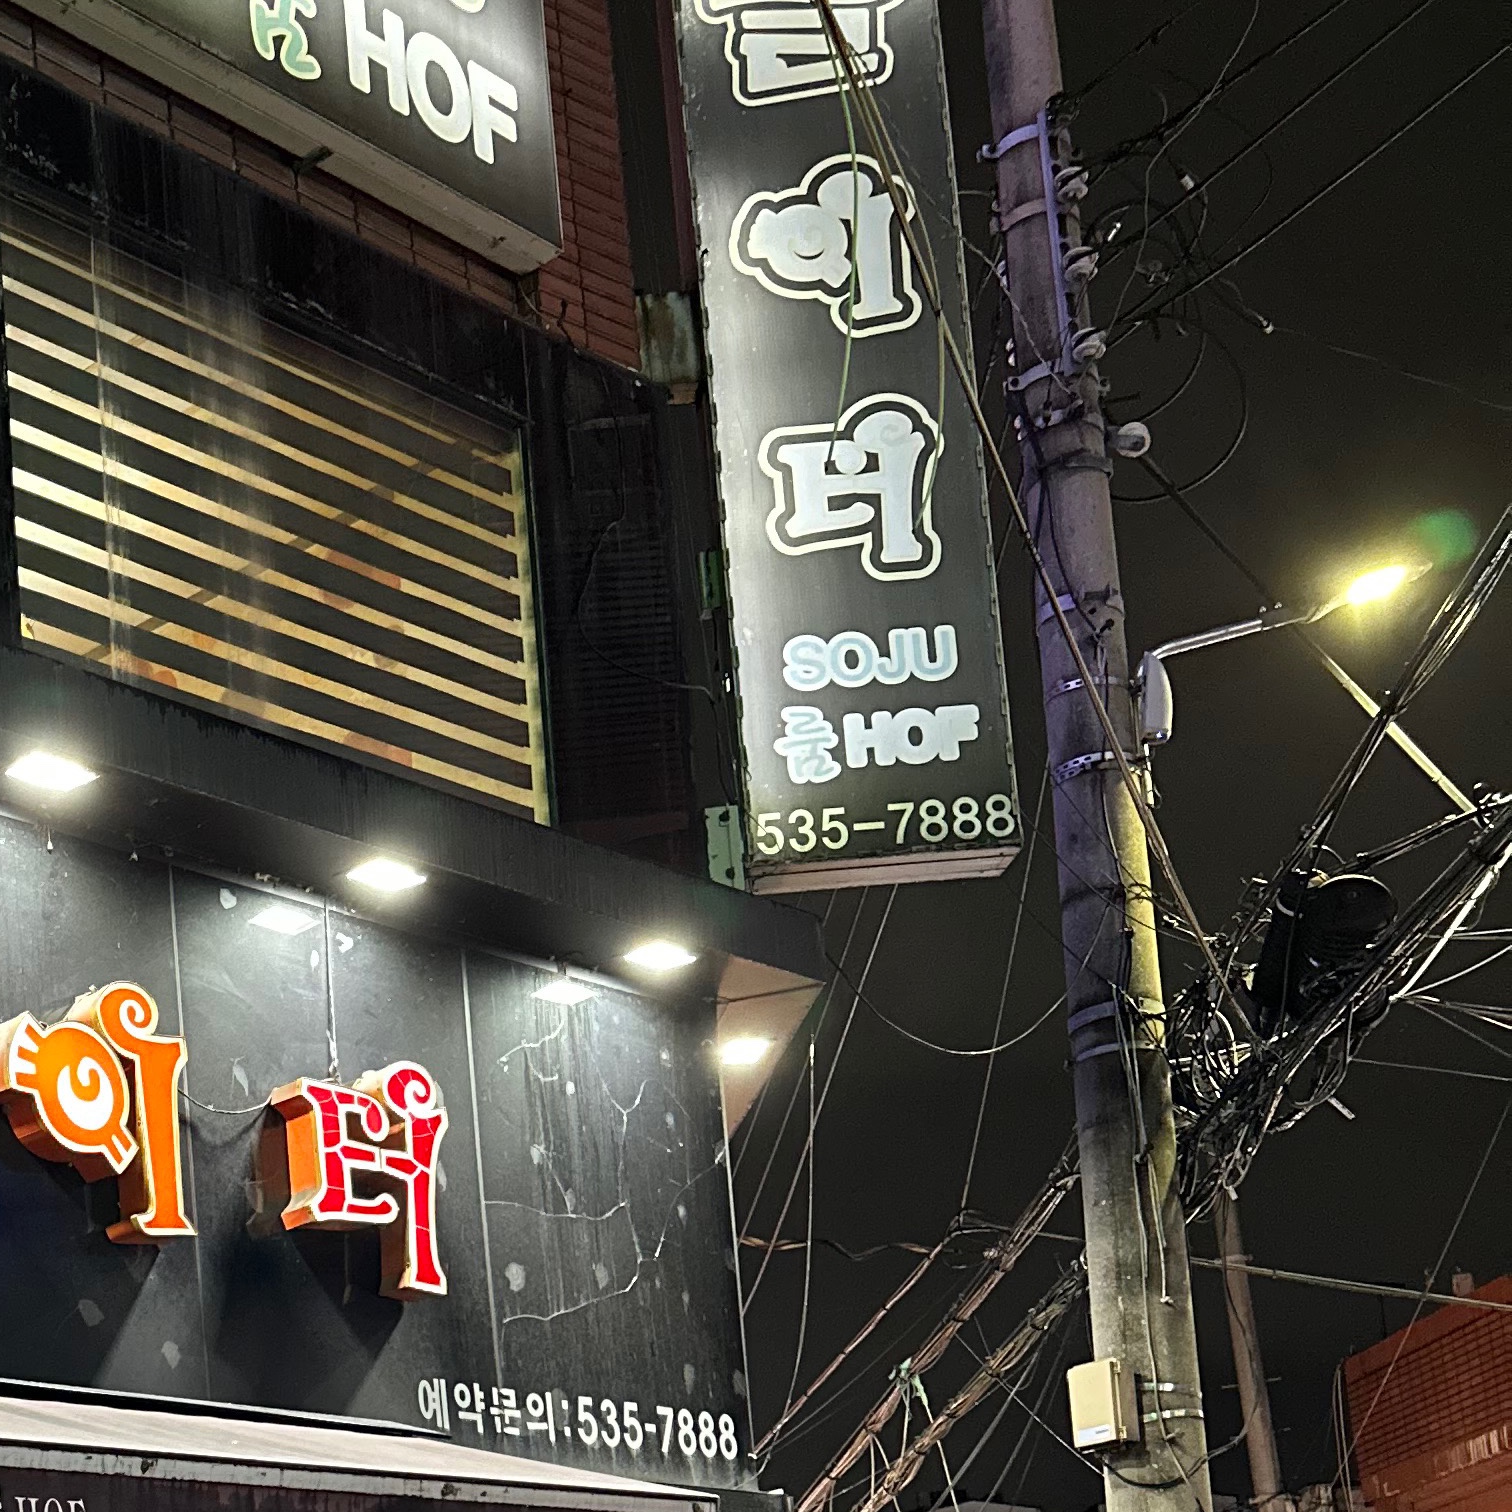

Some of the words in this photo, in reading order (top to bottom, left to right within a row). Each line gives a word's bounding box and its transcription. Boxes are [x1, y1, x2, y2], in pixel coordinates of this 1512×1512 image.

[344, 0, 518, 164] HOF
[782, 625, 958, 692] SOJU
[774, 706, 840, 784] 룸
[844, 704, 980, 770] HOF
[755, 795, 1017, 856] 535-7888
